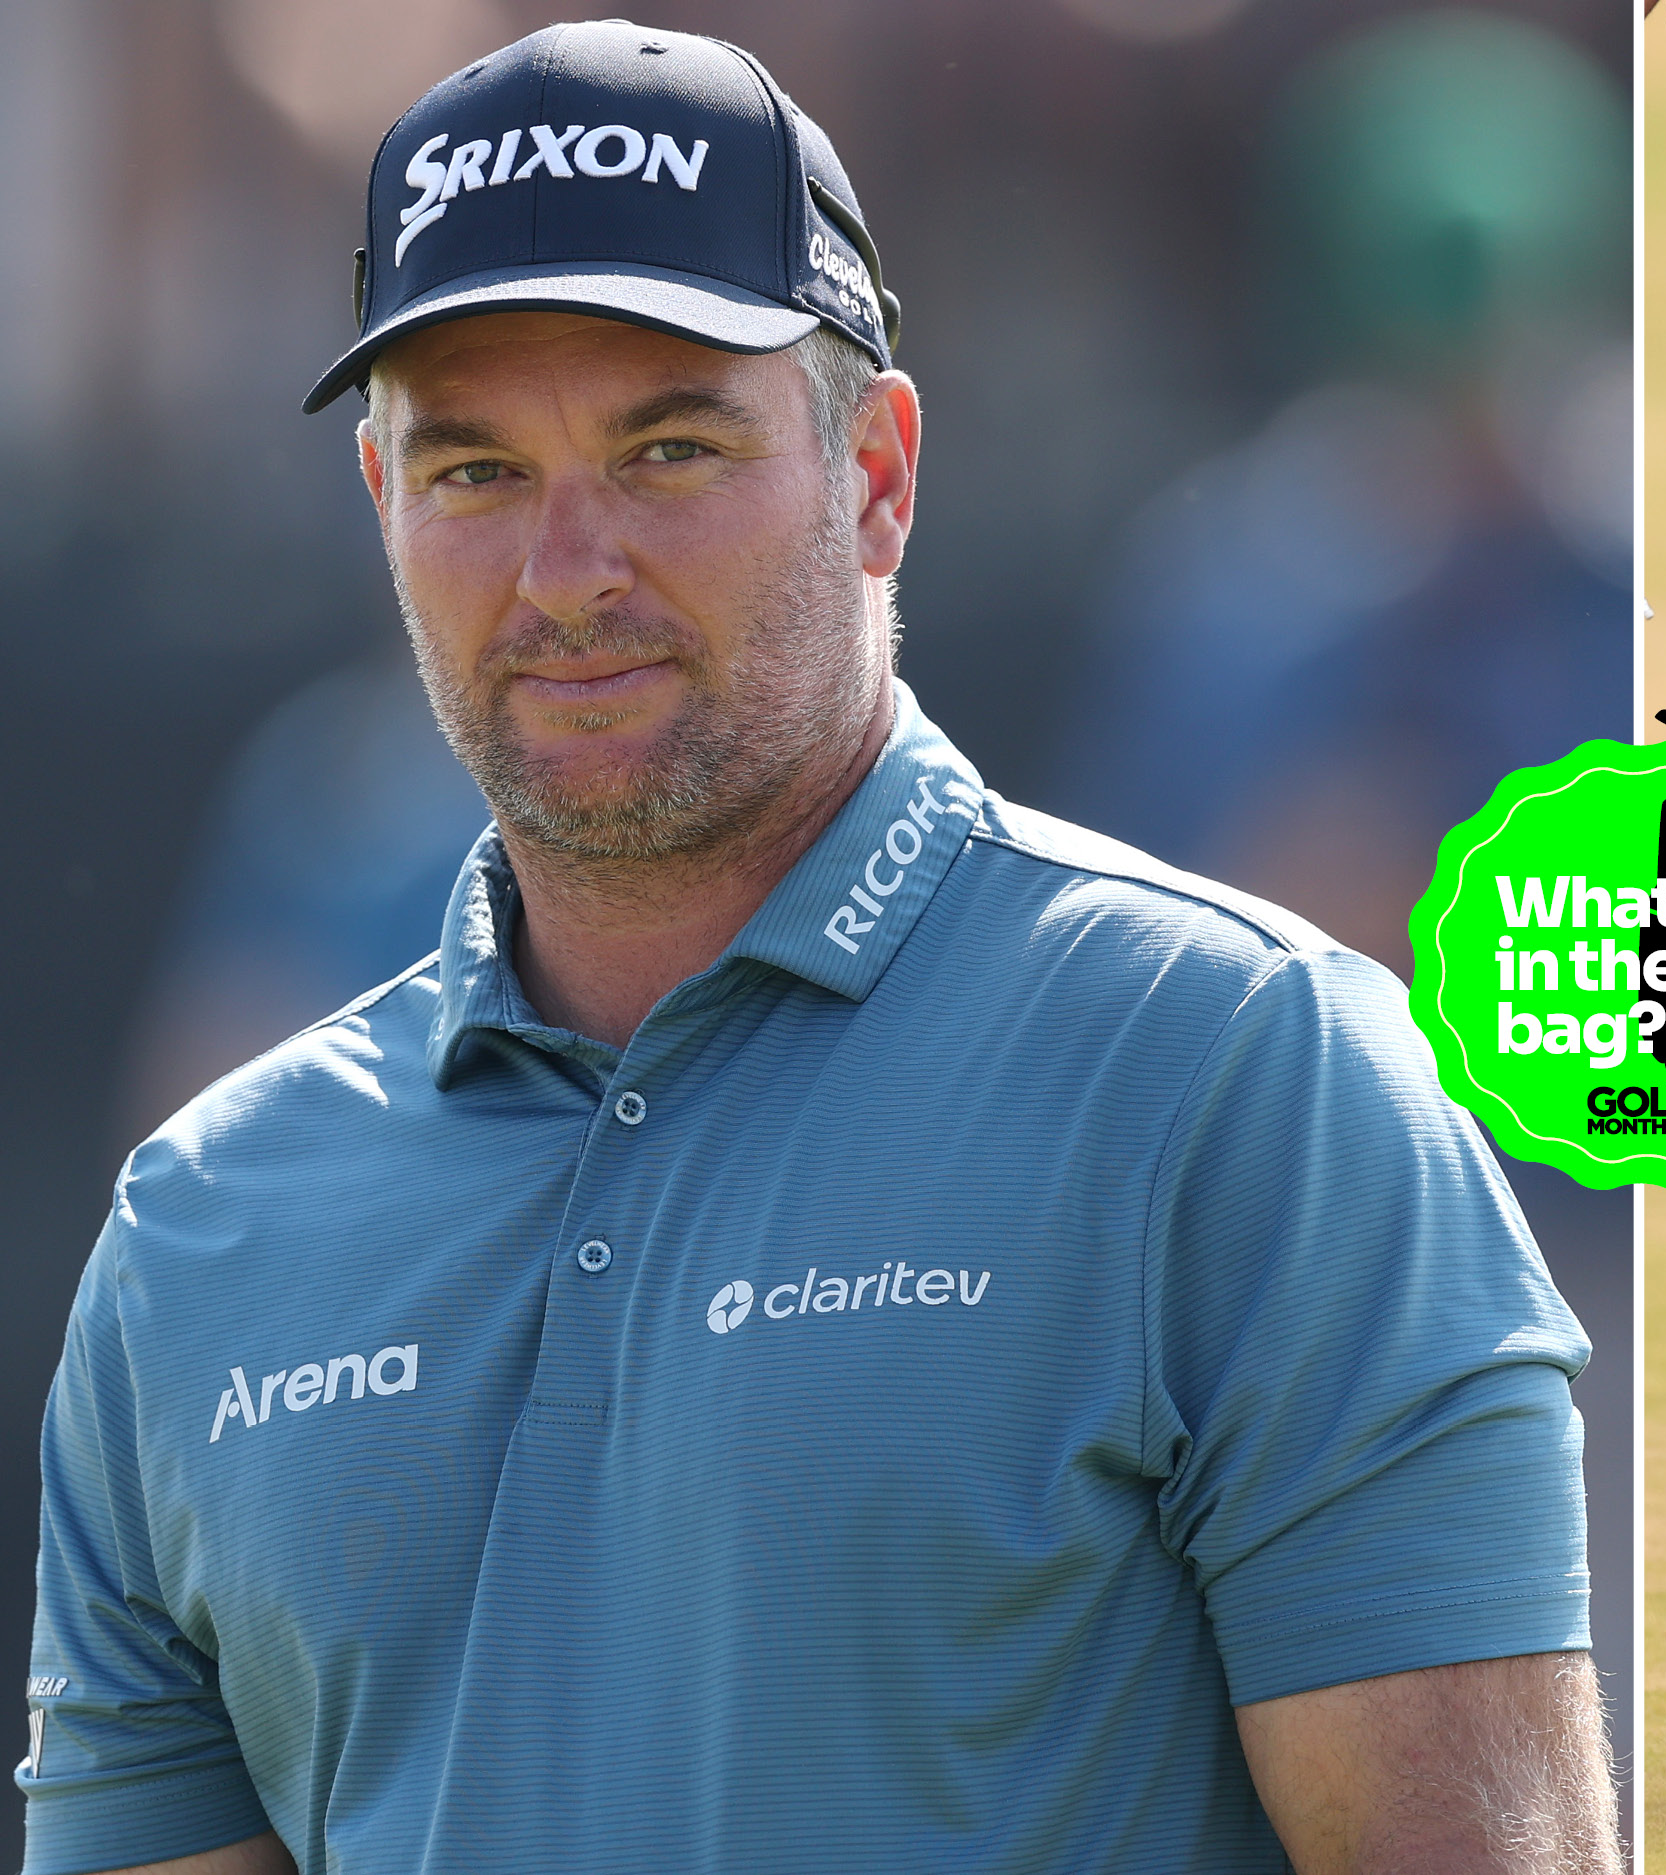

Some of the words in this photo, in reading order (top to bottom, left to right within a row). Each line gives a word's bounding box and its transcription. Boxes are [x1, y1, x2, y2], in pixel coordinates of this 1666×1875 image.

[395, 124, 709, 268] SRIXON
[823, 782, 946, 955] RICOH
[763, 1261, 991, 1319] claritev
[209, 1343, 419, 1444] Arena
[26, 1676, 69, 1699] WEAR
